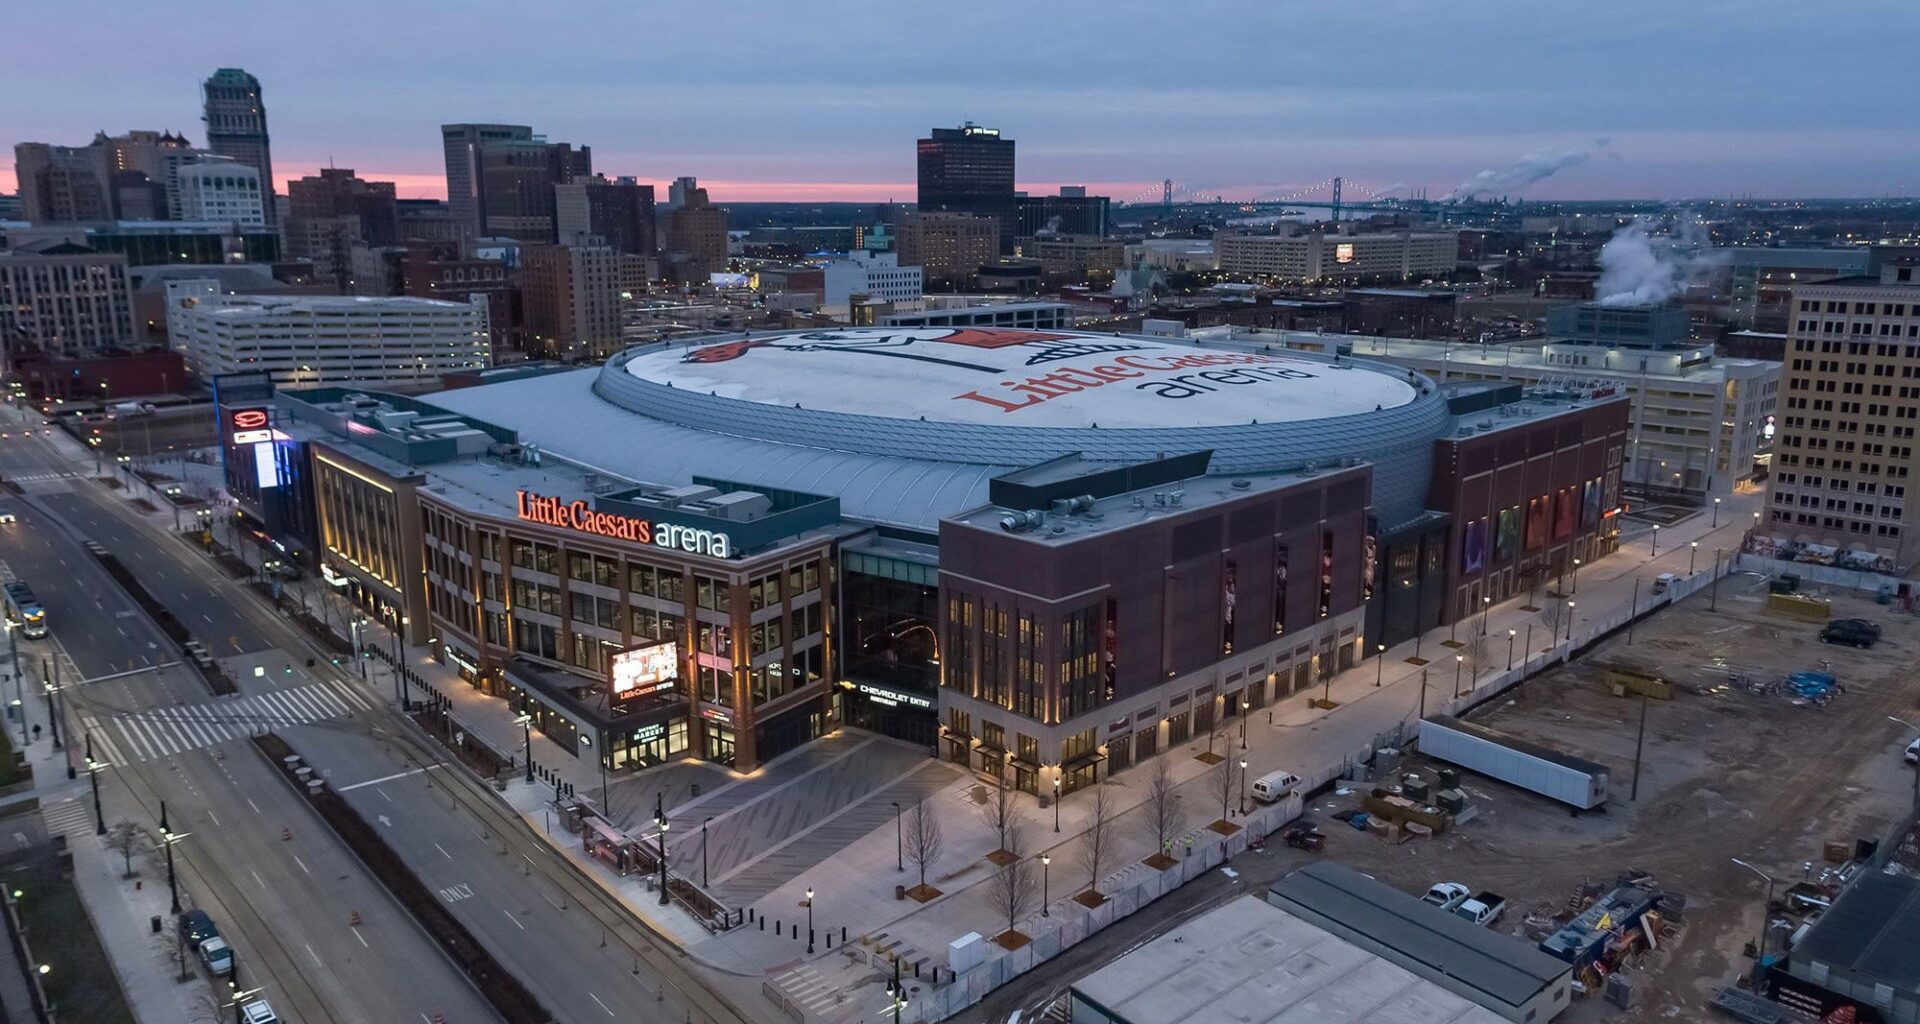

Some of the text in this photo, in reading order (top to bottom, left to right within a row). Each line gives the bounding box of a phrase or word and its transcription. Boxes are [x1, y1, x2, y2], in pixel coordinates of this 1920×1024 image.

[952, 366, 1145, 412] Little
[1136, 366, 1320, 399] arena
[516, 490, 729, 558] Little Caesars arena
[860, 685, 930, 708] CHEVROLET ENTRY
[633, 727, 664, 740] MARKET
[440, 883, 474, 902] ONLY
